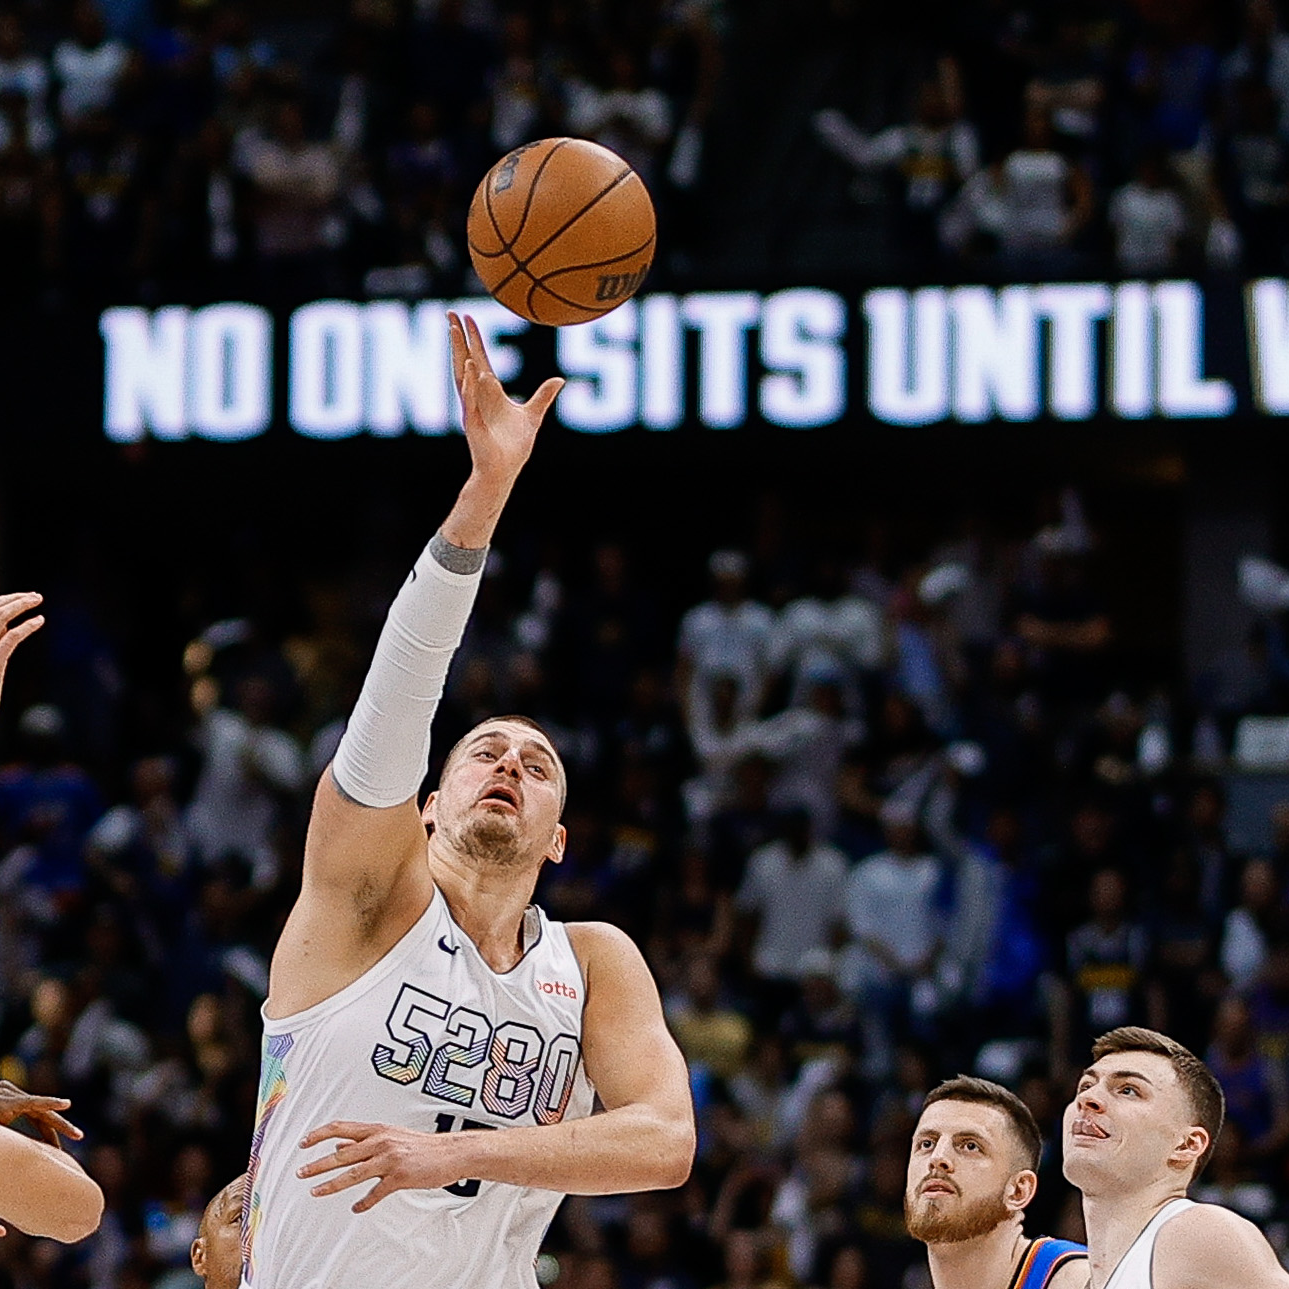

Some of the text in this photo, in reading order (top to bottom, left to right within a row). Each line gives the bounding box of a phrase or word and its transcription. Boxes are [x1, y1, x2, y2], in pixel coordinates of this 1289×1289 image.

[100, 301, 274, 443] NO
[556, 287, 847, 434] SITS
[864, 280, 1234, 427] UNTIL
[372, 983, 583, 1126] 5280
[535, 979, 578, 1000] otta
